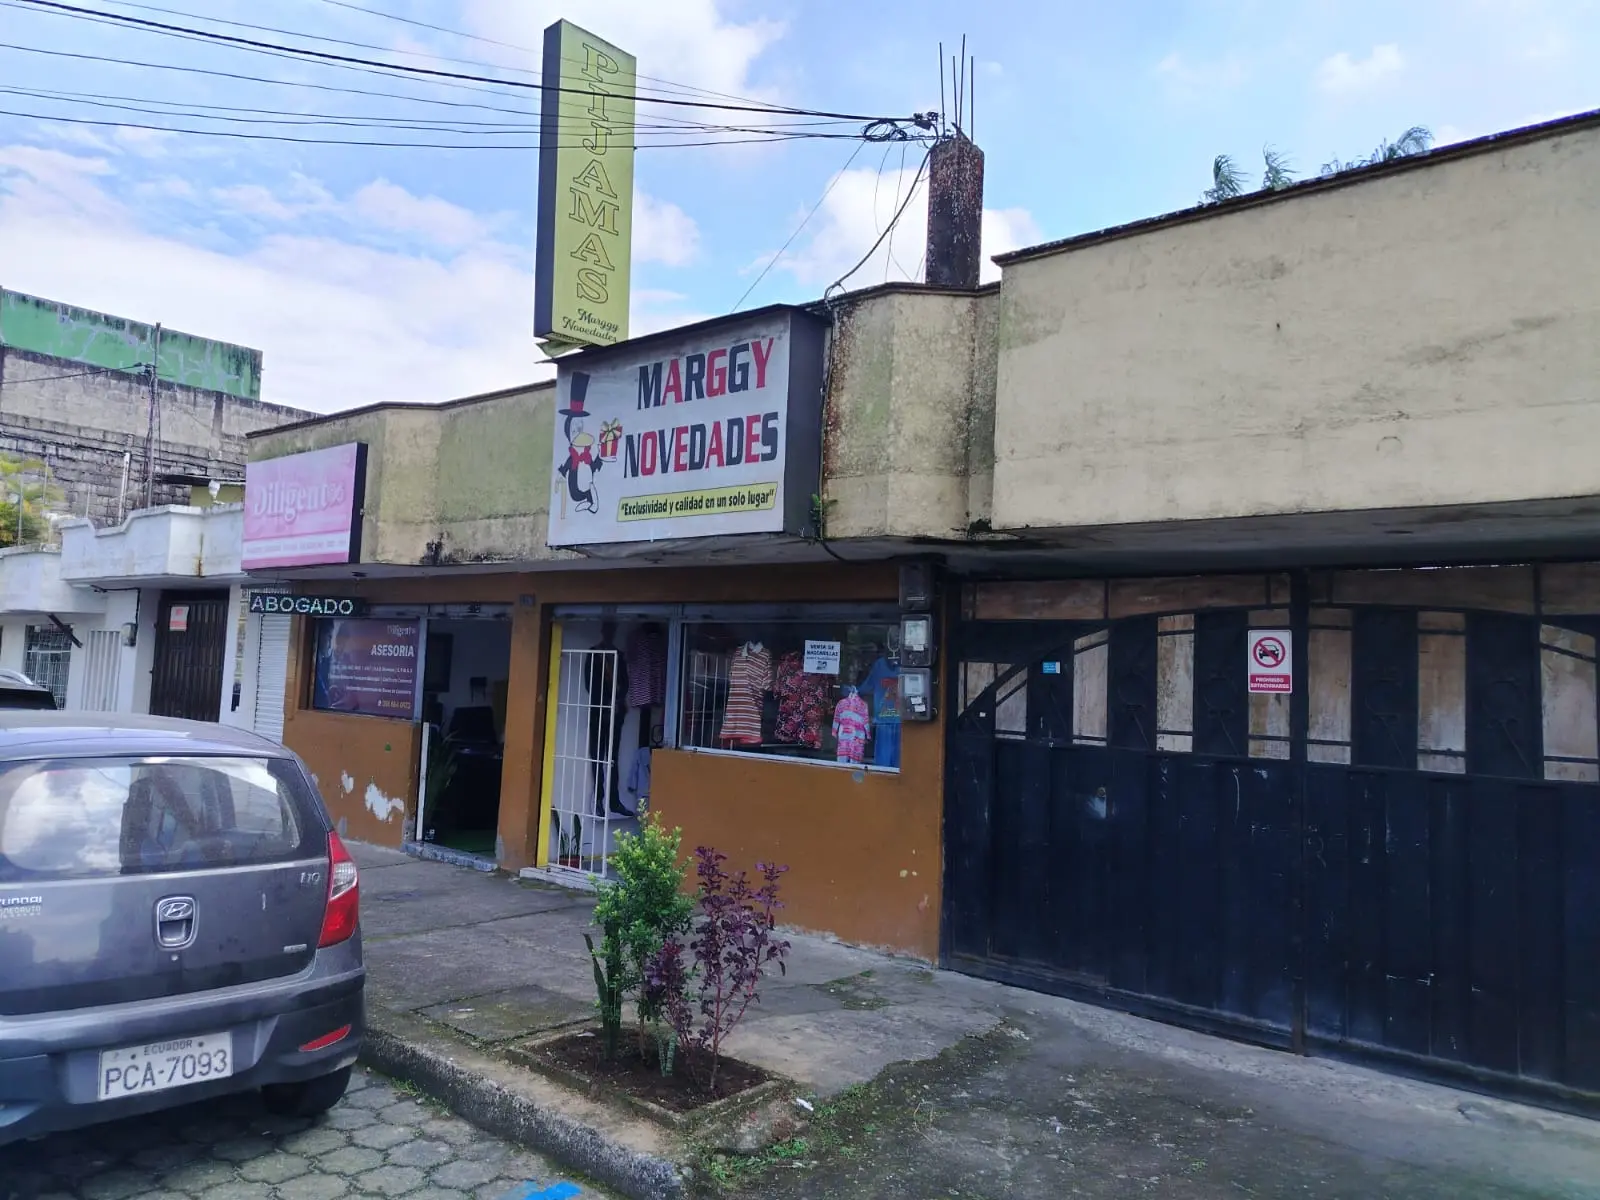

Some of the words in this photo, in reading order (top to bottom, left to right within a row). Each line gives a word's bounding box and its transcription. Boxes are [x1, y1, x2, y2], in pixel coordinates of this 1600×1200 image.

[569, 42, 619, 304] PIJAMAS
[562, 316, 617, 343] Novedades
[577, 308, 619, 333] Marggy
[637, 337, 774, 410] MARGGY
[623, 412, 779, 478] NOVEDADES
[668, 502, 674, 515] y
[675, 495, 703, 511] calidad
[705, 498, 715, 509] en
[716, 496, 727, 507] un
[728, 491, 745, 506] solo
[251, 595, 354, 615] ABOGADO
[371, 644, 415, 657] ASESORIA
[143, 1040, 193, 1056] ECUADOR
[104, 1049, 228, 1095] PCA-7093
